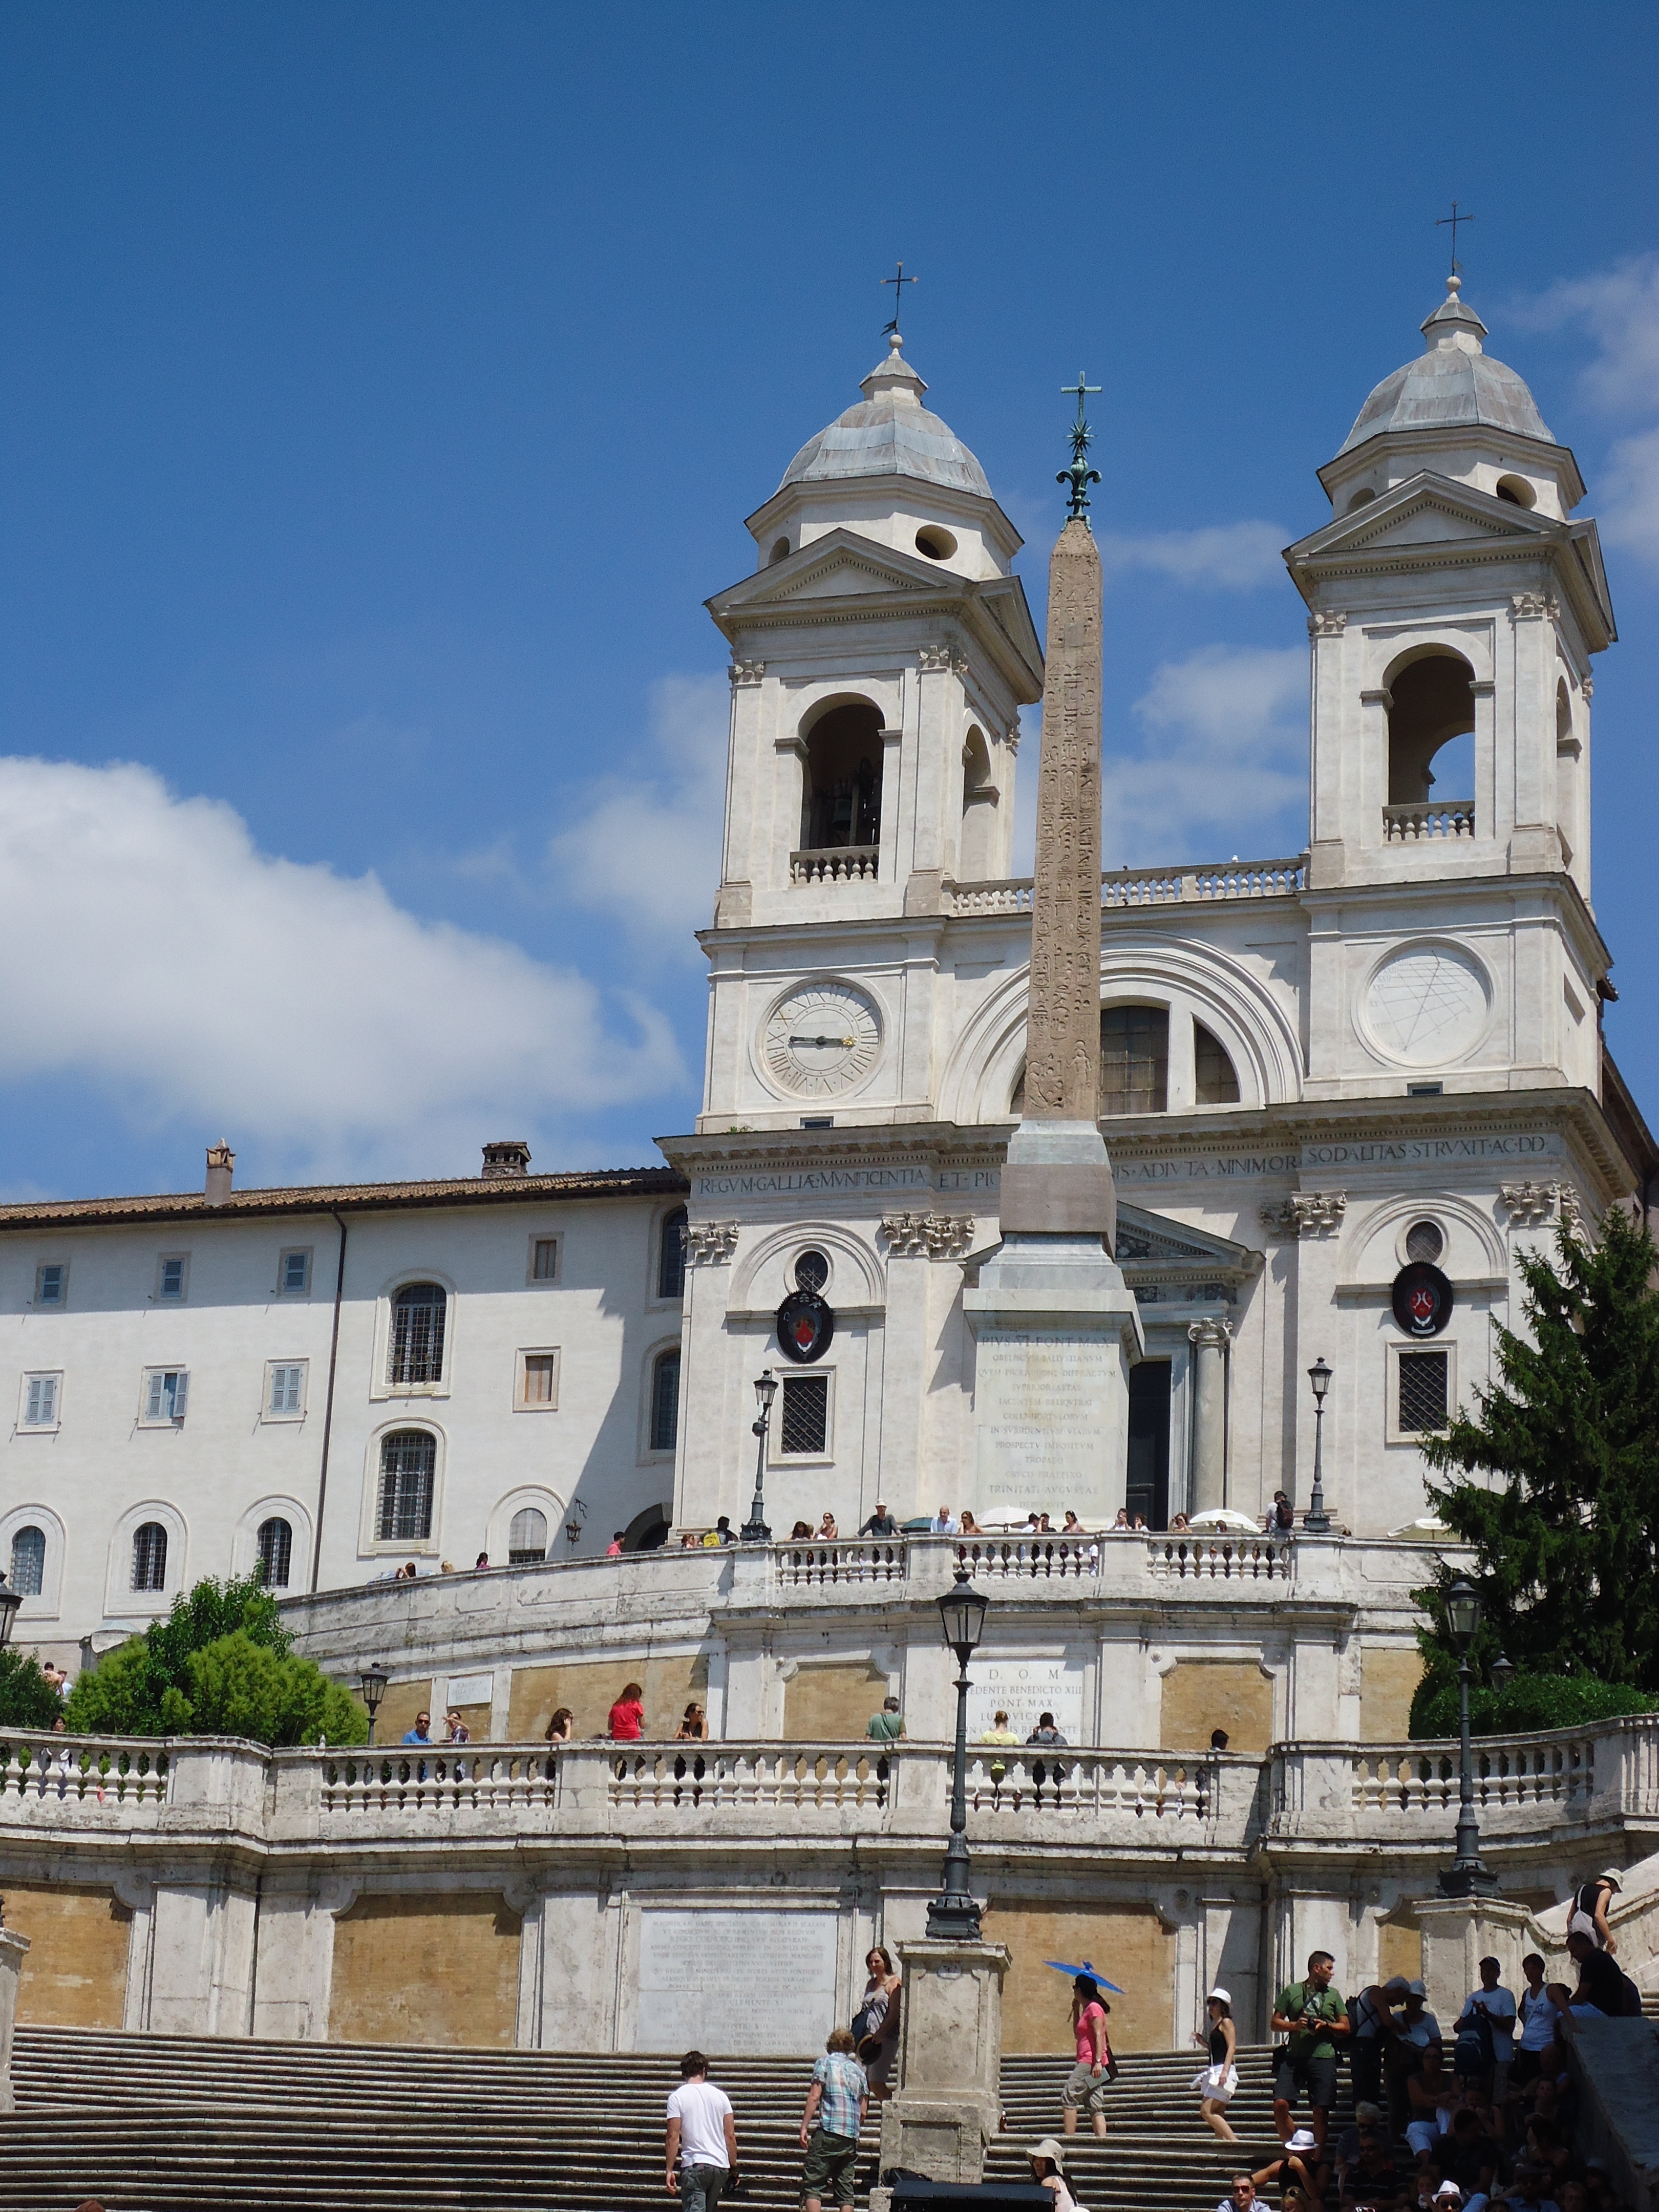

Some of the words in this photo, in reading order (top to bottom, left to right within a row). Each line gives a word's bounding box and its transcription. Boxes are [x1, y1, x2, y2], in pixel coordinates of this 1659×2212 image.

[700, 1177, 753, 1194] REGVM
[940, 1172, 965, 1187] ET
[1138, 1160, 1208, 1179] ADIVTA
[1308, 1143, 1406, 1163] SODALITAS
[1412, 1138, 1488, 1158] STRVXIT
[1491, 1138, 1514, 1154] AC
[1519, 1136, 1544, 1153] DD
[982, 1336, 1010, 1346] PIVS
[1016, 1335, 1029, 1346] VI
[1036, 1336, 1072, 1347] PONT
[1078, 1337, 1111, 1347] MAX
[992, 1354, 1039, 1363] OBELISCVM
[979, 1369, 1001, 1377] QVEM
[1045, 1398, 1093, 1407] RELIQVERAT
[988, 1485, 1039, 1494] TRINITATI
[1046, 1486, 1099, 1495] AVGVSTAE
[989, 1669, 1003, 1680] D.
[1018, 1669, 1032, 1680] O.
[1048, 1669, 1064, 1680] M.
[1010, 1686, 1061, 1695] BENEDICTO
[1065, 1686, 1081, 1695] XIII
[990, 1699, 1021, 1708] PONT
[1028, 1699, 1053, 1707] MAX
